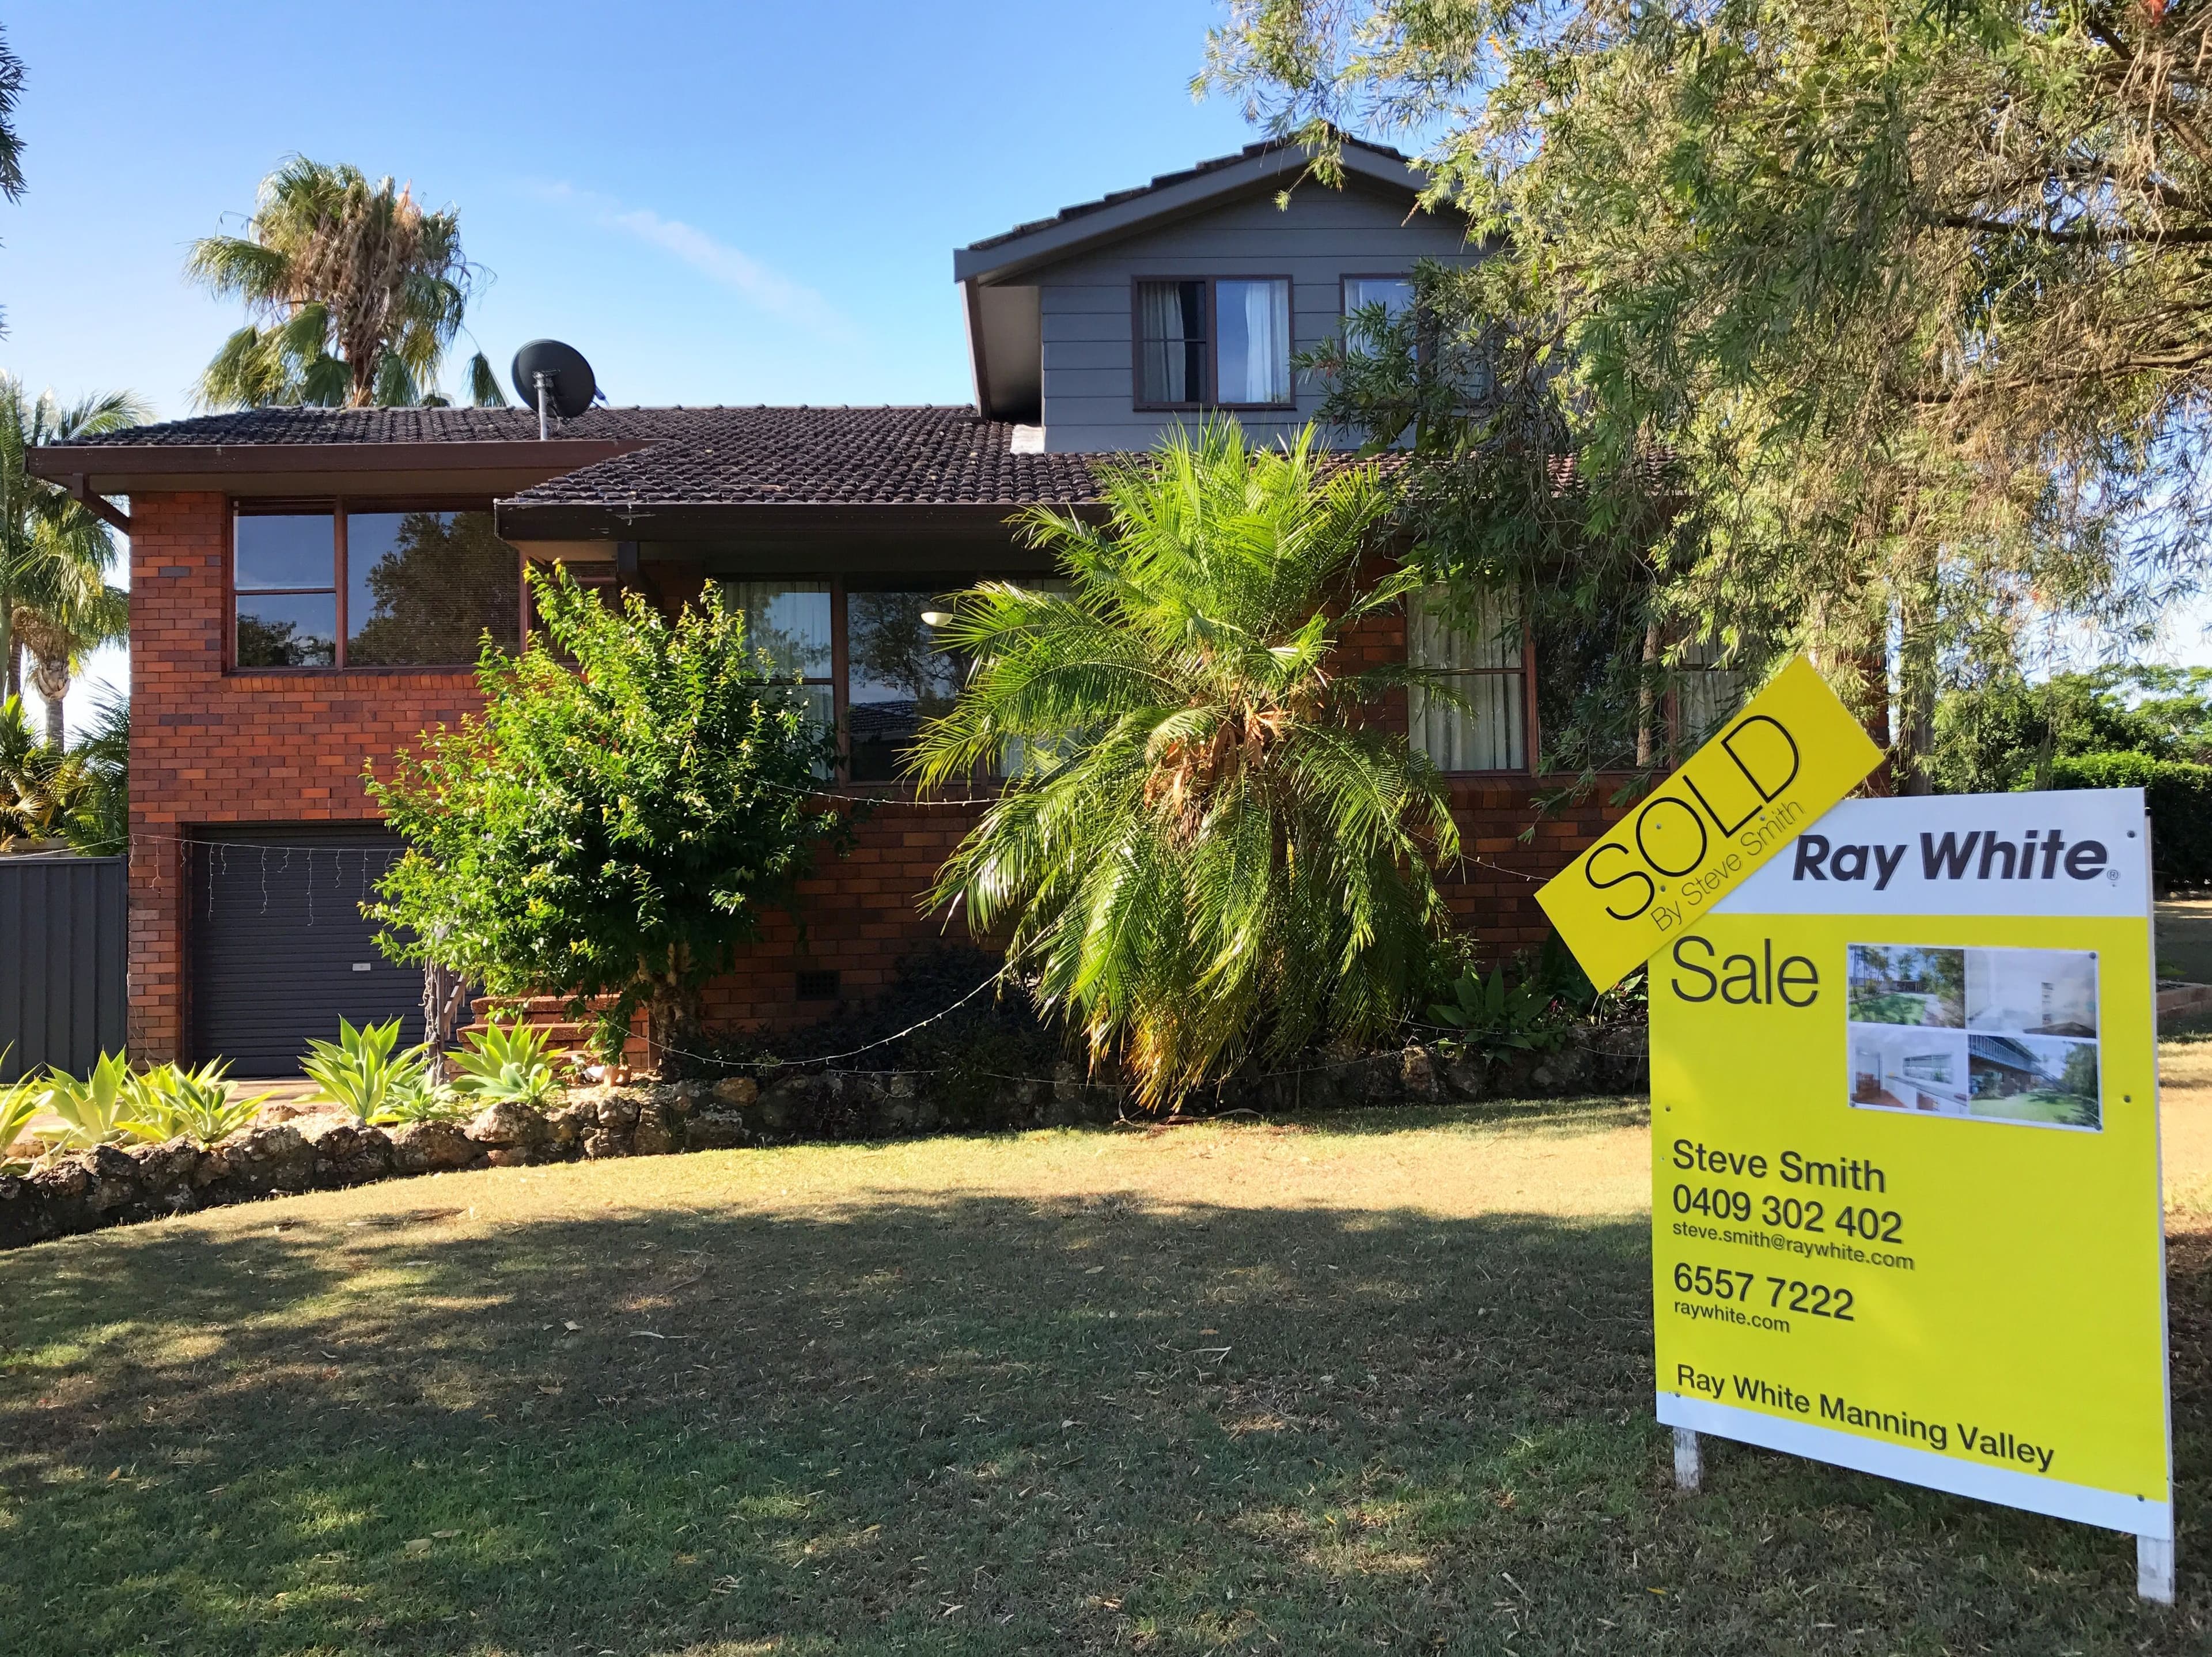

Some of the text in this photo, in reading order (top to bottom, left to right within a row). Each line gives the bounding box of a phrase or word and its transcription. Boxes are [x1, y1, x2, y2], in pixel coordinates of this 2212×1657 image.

[1585, 715, 1800, 920] SOLD
[1651, 800, 1806, 932] By Steve Smith
[1793, 834, 1908, 891] Ray
[1671, 936, 1819, 1008] Sale
[1672, 1139, 1886, 1193] Steve Smith
[1673, 1184, 1904, 1244] 0409 302 402
[1672, 1221, 1915, 1270] steve.smith@raywhite.com
[1673, 1262, 1854, 1321] 6557 7222
[1674, 1300, 1791, 1333] raywhite.com
[1677, 1364, 2055, 1472] Ray White Manning Valley
